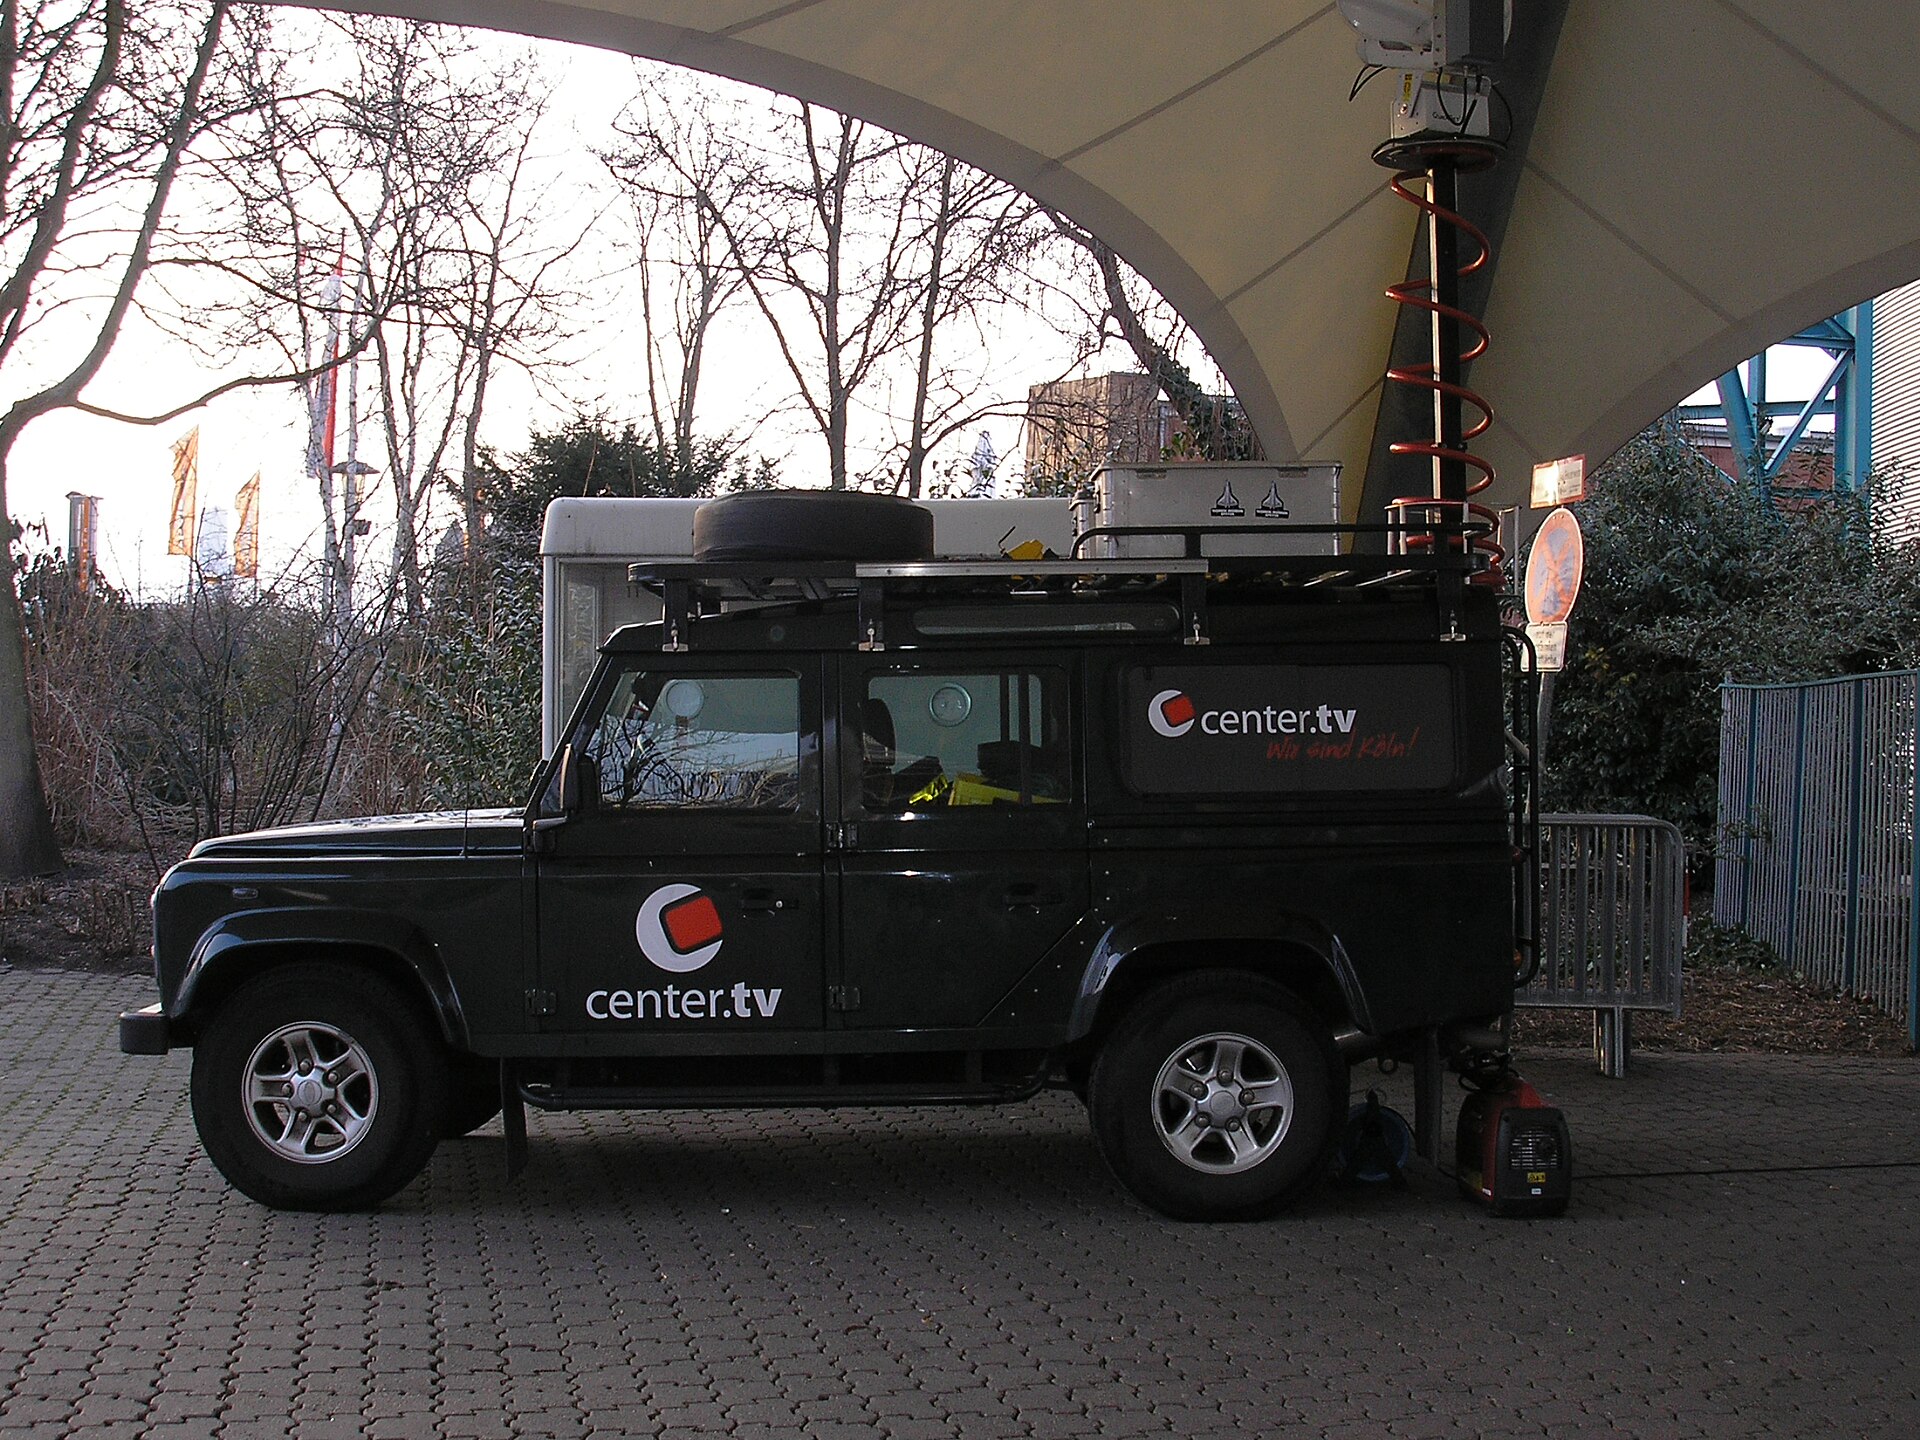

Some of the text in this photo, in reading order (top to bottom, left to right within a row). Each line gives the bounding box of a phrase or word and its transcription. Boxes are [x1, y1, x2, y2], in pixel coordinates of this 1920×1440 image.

[1200, 703, 1357, 735] center.tv
[1266, 725, 1421, 760] Wir sind Köln!
[585, 980, 783, 1020] center.tv
